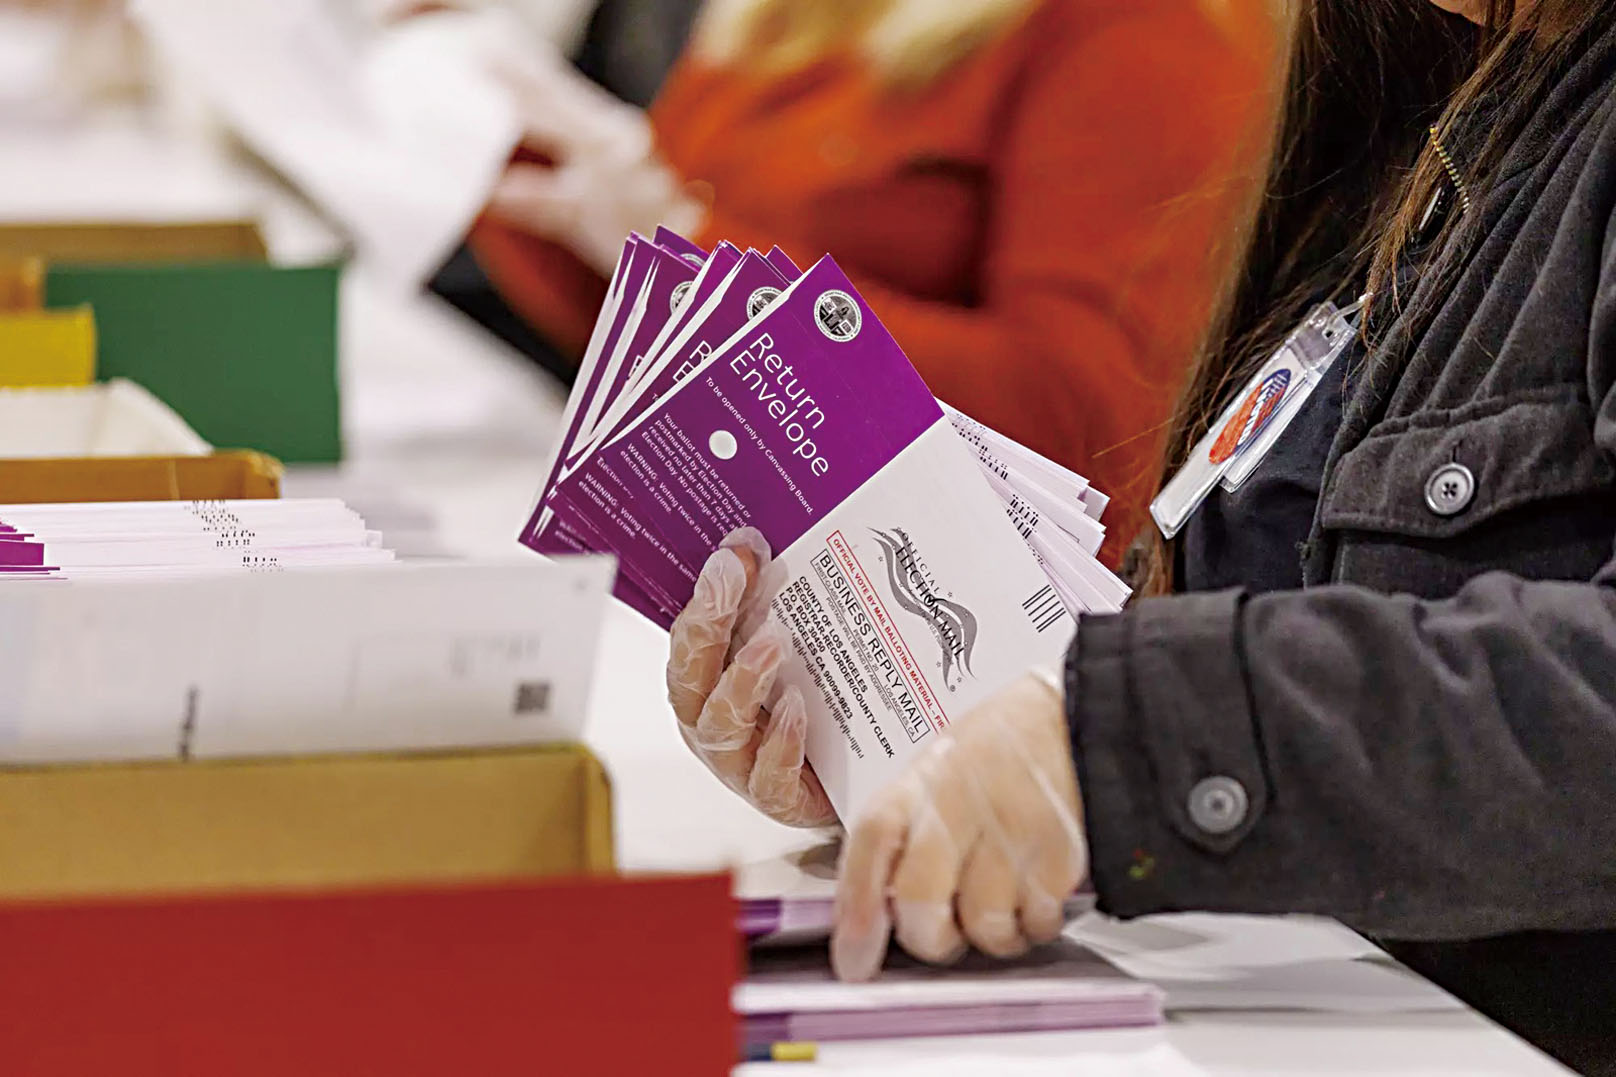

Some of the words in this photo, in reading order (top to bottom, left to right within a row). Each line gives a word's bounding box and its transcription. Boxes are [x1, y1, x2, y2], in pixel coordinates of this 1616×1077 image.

[729, 349, 829, 477] Envelope
[749, 332, 825, 430] Return
[578, 480, 605, 508] election
[604, 506, 611, 515] is
[620, 450, 645, 480] election
[643, 478, 650, 487] is
[641, 431, 666, 462] Election
[677, 475, 688, 488] No
[685, 487, 712, 516] postage
[710, 514, 718, 524] is
[648, 425, 676, 457] received
[672, 455, 683, 467] no
[681, 465, 697, 483] later
[695, 482, 712, 501] than
[715, 505, 730, 524] days
[654, 419, 692, 462] postmarked
[689, 459, 699, 471] by
[697, 469, 723, 500] Election
[721, 497, 735, 514] Day
[663, 412, 679, 430] Your
[676, 429, 696, 452] ballot
[694, 451, 711, 471] must
[709, 468, 719, 480] be
[717, 479, 746, 511] returned
[742, 510, 751, 518] or
[705, 376, 715, 388] To
[712, 385, 723, 397] be
[721, 396, 747, 424] opened
[743, 423, 759, 440] only
[756, 438, 766, 450] by
[764, 449, 797, 492] Canvassing
[794, 489, 814, 514] Board.
[620, 507, 642, 532] Voting
[641, 527, 660, 547] twice
[659, 545, 668, 555] in
[666, 552, 679, 565] the
[678, 563, 697, 582] same
[659, 482, 679, 508] Voting
[677, 505, 695, 526] twice
[693, 525, 702, 534] in
[700, 532, 712, 545] the
[899, 532, 940, 593] OFFICIAL
[778, 591, 794, 613] LOS
[789, 613, 818, 657] ANGELES
[815, 656, 826, 672] CA
[823, 670, 853, 720] 90099-9823
[785, 586, 798, 606] P.O.
[795, 604, 811, 627] BOX
[807, 626, 826, 653] 30450
[799, 575, 825, 614] COUNTY
[821, 614, 833, 628] OF
[828, 628, 844, 649] LOS
[839, 649, 868, 693] ANGELES
[814, 561, 839, 601] FIRST-CLASS
[836, 599, 846, 614] MAIL
[852, 628, 869, 652] PERMIT
[871, 663, 880, 672] 20
[883, 683, 894, 698] LOS
[907, 726, 916, 737] CA
[819, 554, 872, 637] BUSINESS
[867, 637, 903, 688] REPLY
[897, 691, 923, 733] MAIL
[825, 596, 844, 627] POSTAGE
[842, 625, 852, 642] WILL
[850, 640, 858, 649] BE
[855, 649, 867, 665] PAID
[863, 664, 872, 674] BY
[868, 674, 893, 711] ADDRESSEE
[833, 538, 856, 574] OFFICIAL
[854, 572, 870, 595] VOTE
[866, 594, 877, 606] BY
[873, 606, 886, 627] MAIL
[884, 625, 912, 671] BALLOTING
[909, 670, 933, 710] MATERIAL
[894, 544, 947, 622] ELECTION
[936, 618, 970, 662] MAIL
[792, 580, 877, 725] REGISTRAR-RECORDER/COUNTY
[873, 725, 895, 759] CLERK
